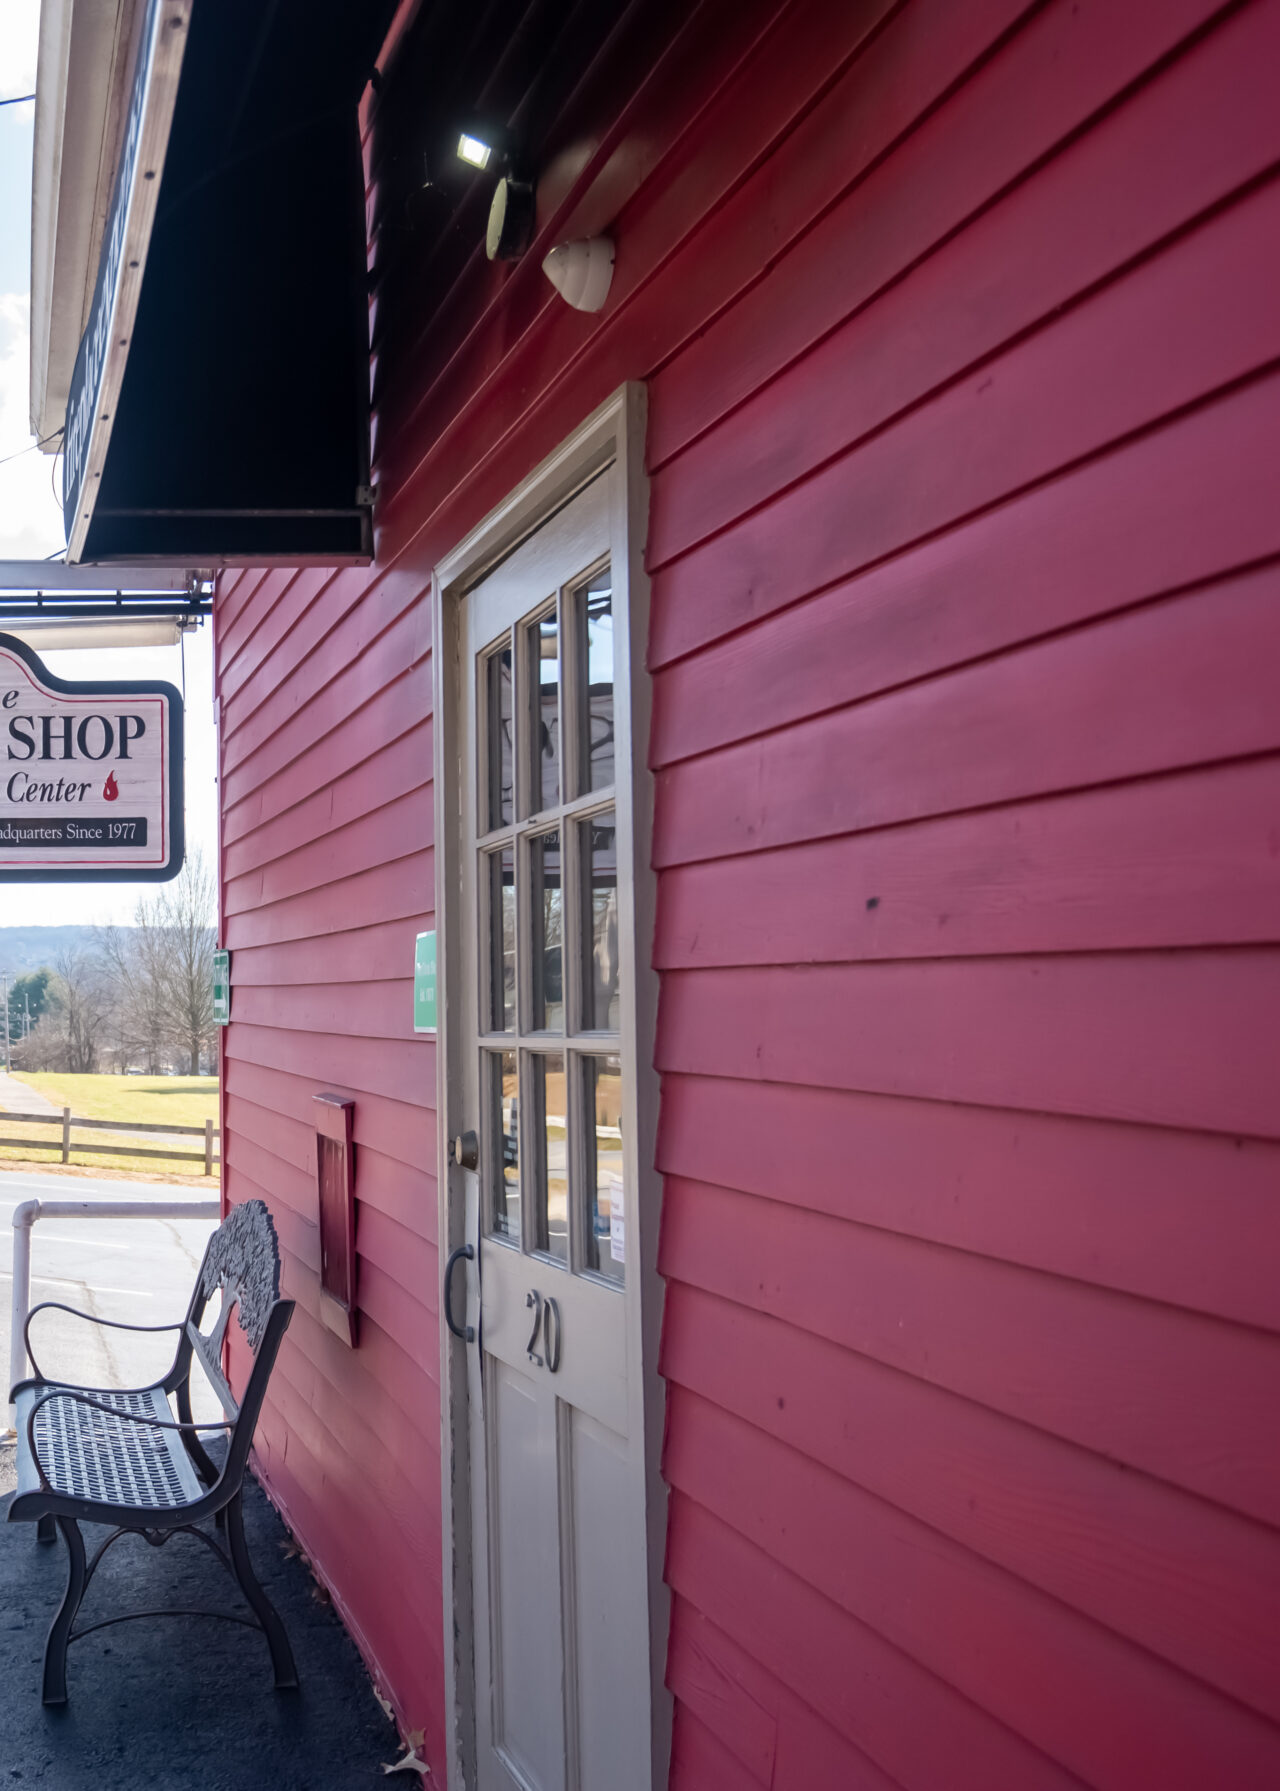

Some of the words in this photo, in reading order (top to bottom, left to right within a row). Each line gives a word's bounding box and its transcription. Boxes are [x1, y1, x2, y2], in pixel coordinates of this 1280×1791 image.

[7, 715, 146, 761] SHOP
[7, 771, 92, 803] Center
[67, 823, 103, 839] Since
[108, 823, 136, 840] 1977
[526, 1289, 561, 1373] 20
